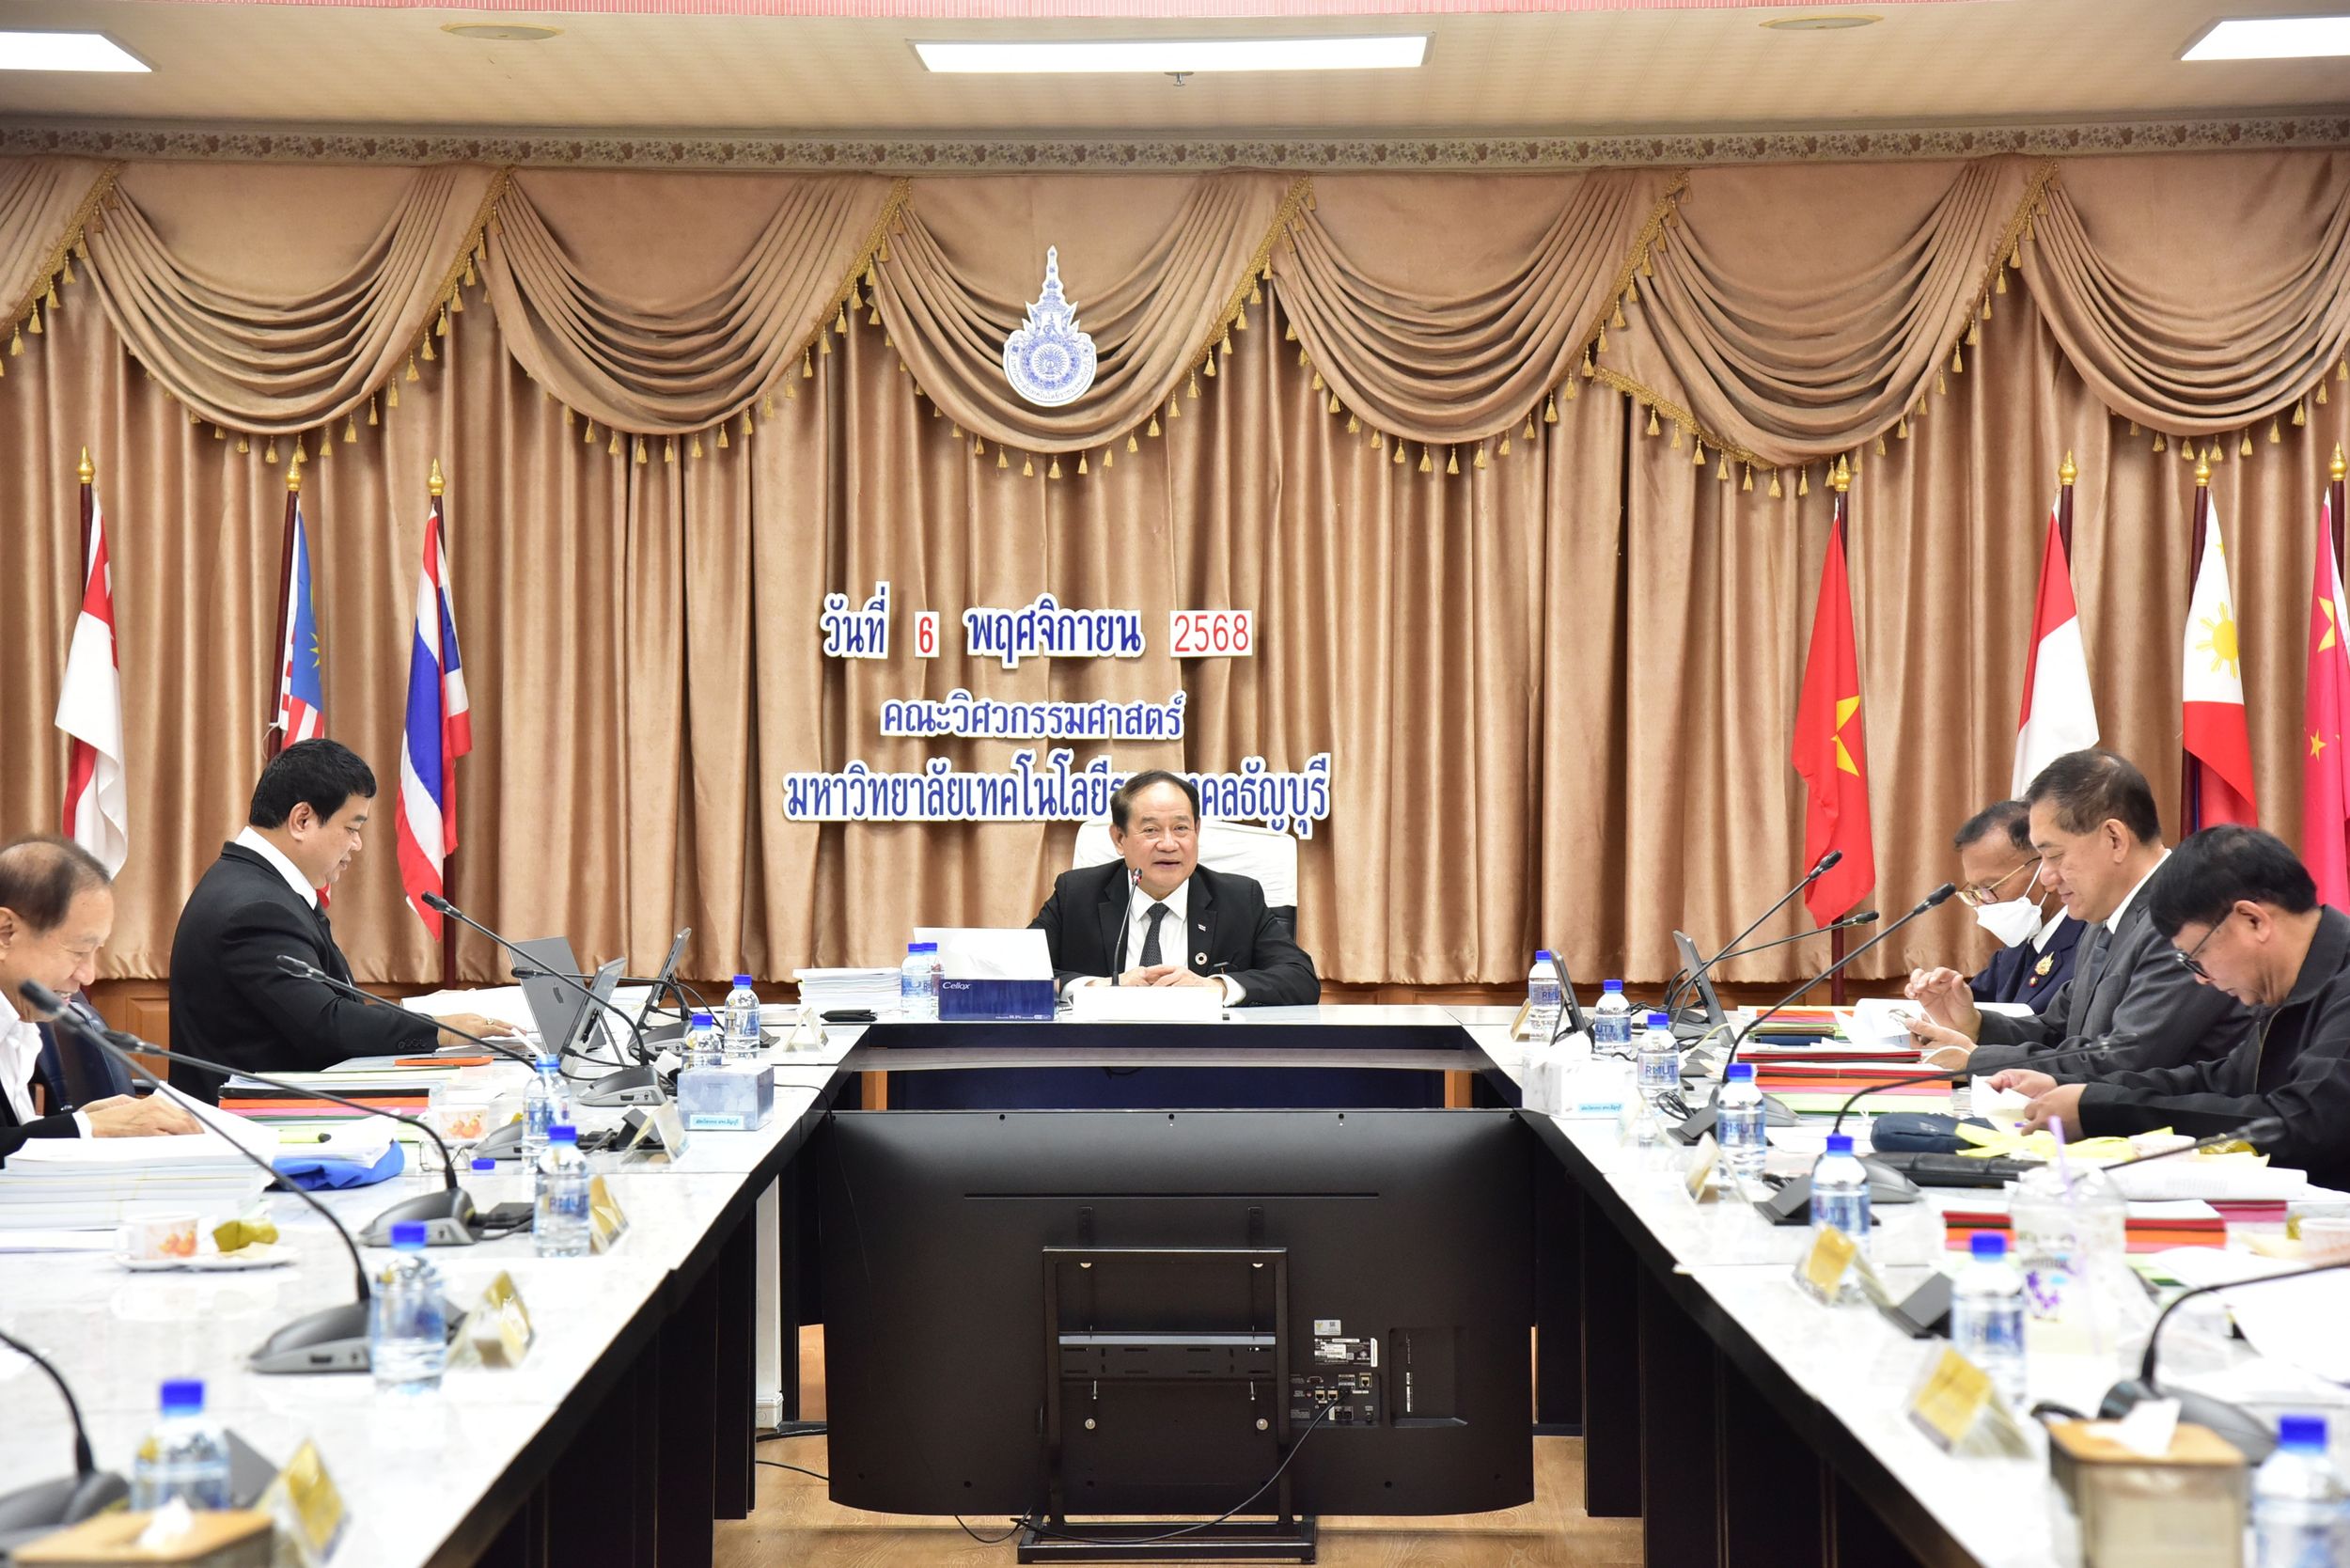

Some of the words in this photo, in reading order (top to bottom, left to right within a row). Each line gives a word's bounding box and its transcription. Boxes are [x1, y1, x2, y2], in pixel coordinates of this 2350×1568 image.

[824, 585, 886, 654] วันที่
[918, 616, 934, 654] 6
[966, 597, 1142, 664] พฤศจิกายน
[1174, 613, 1250, 652] 2568
[884, 691, 1183, 736] คณะวิศวกรรมศาสตร์
[787, 751, 1327, 836] มหาวิทยาลัยเทคโนโลยีคลธัญบุรี
